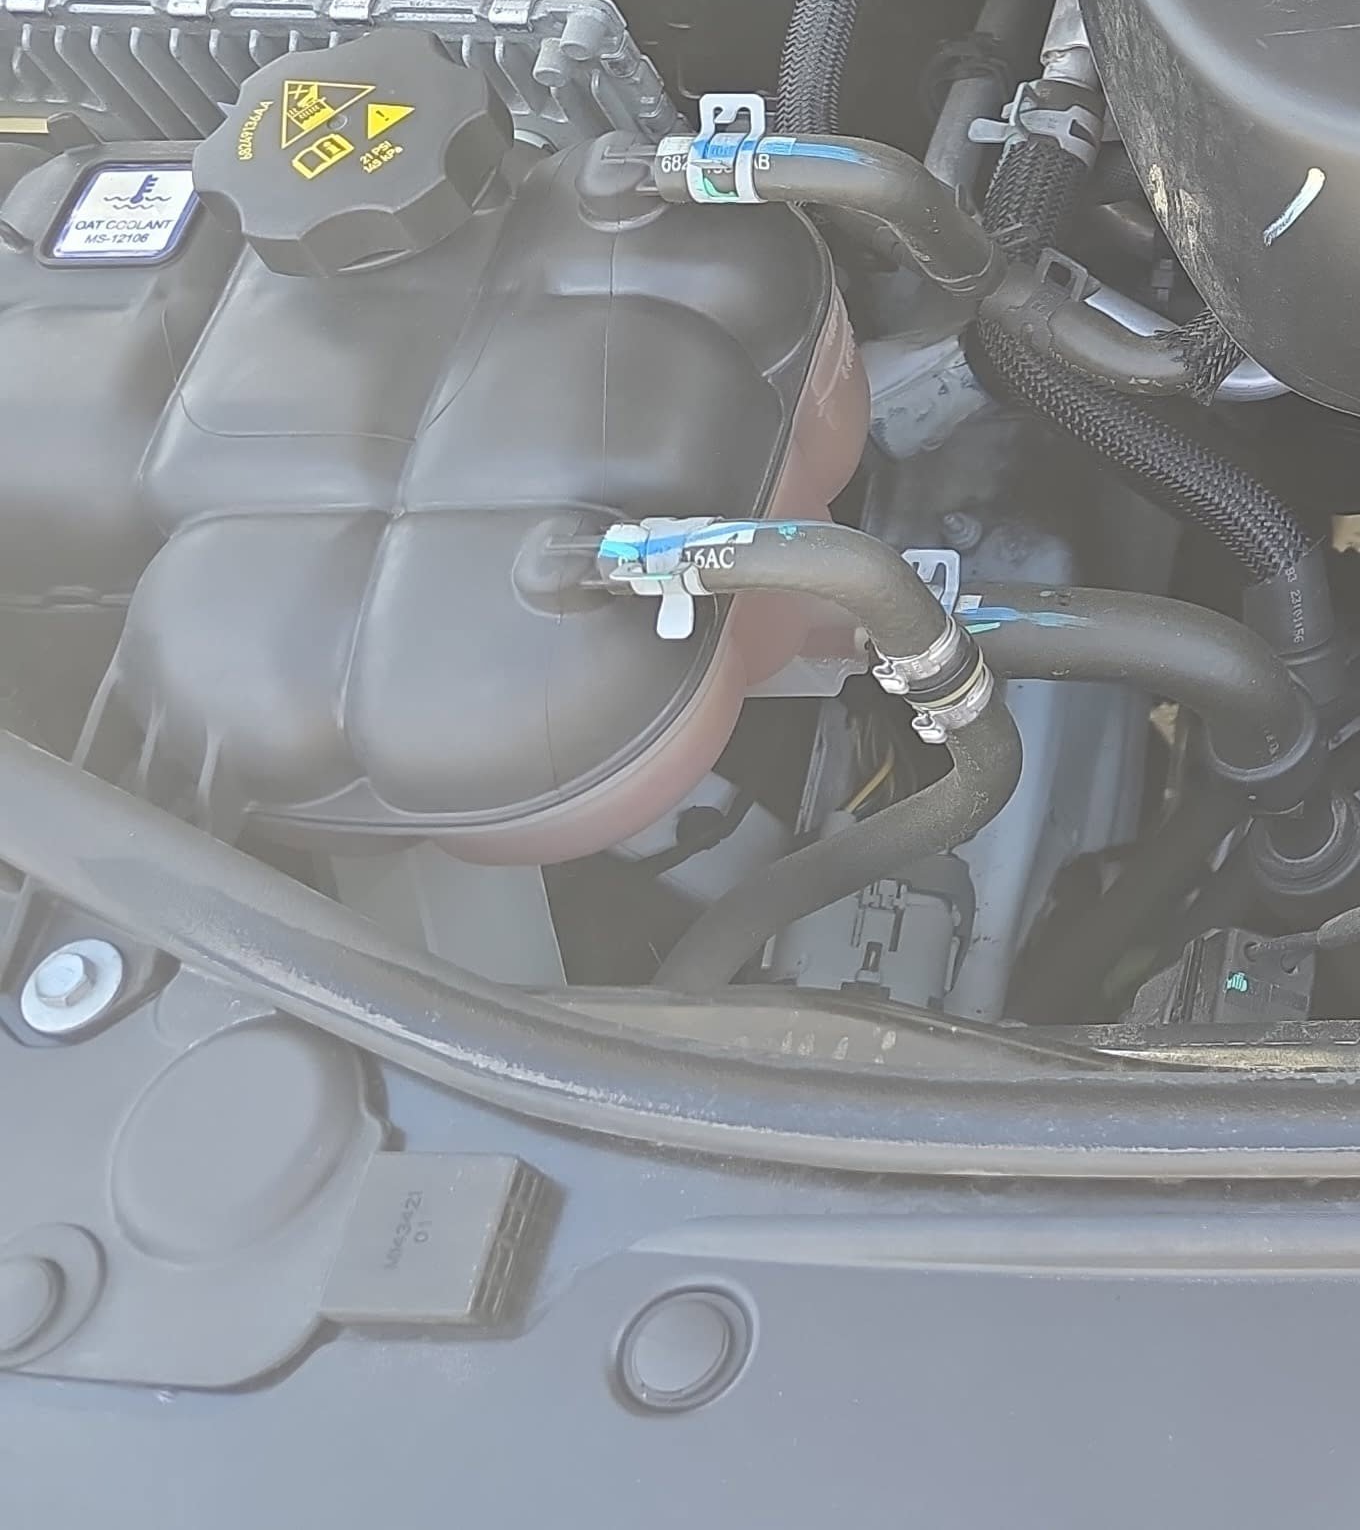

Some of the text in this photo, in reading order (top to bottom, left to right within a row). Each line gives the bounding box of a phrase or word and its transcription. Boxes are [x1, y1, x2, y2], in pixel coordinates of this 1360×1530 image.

[371, 140, 392, 156] PSI
[74, 219, 174, 230] OAT COOLANT
[84, 233, 150, 244] MS-12106
